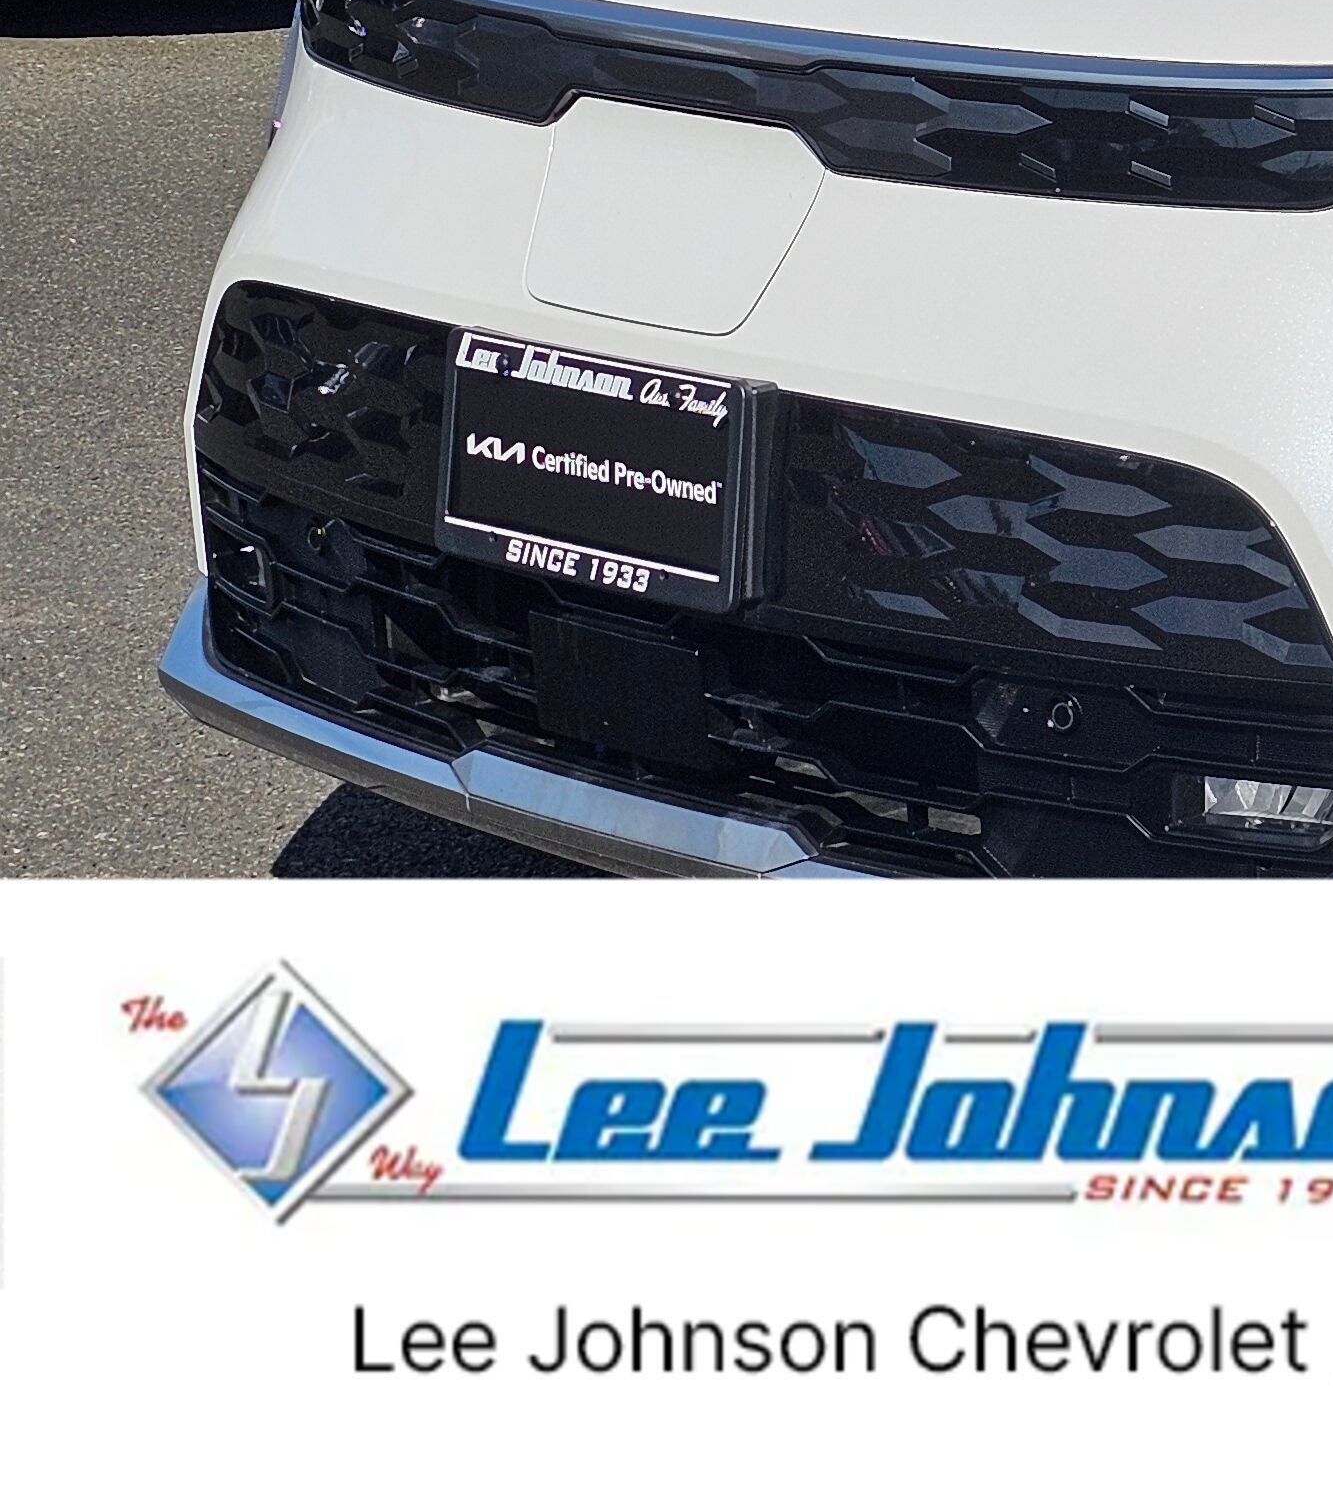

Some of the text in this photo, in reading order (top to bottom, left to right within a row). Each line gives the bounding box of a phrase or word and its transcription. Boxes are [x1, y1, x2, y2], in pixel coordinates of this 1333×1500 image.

[511, 344, 634, 401] Johnson
[676, 383, 729, 428] Family
[466, 432, 526, 465] KIA
[531, 445, 611, 484] Certified
[505, 538, 651, 594] SINCE 1933
